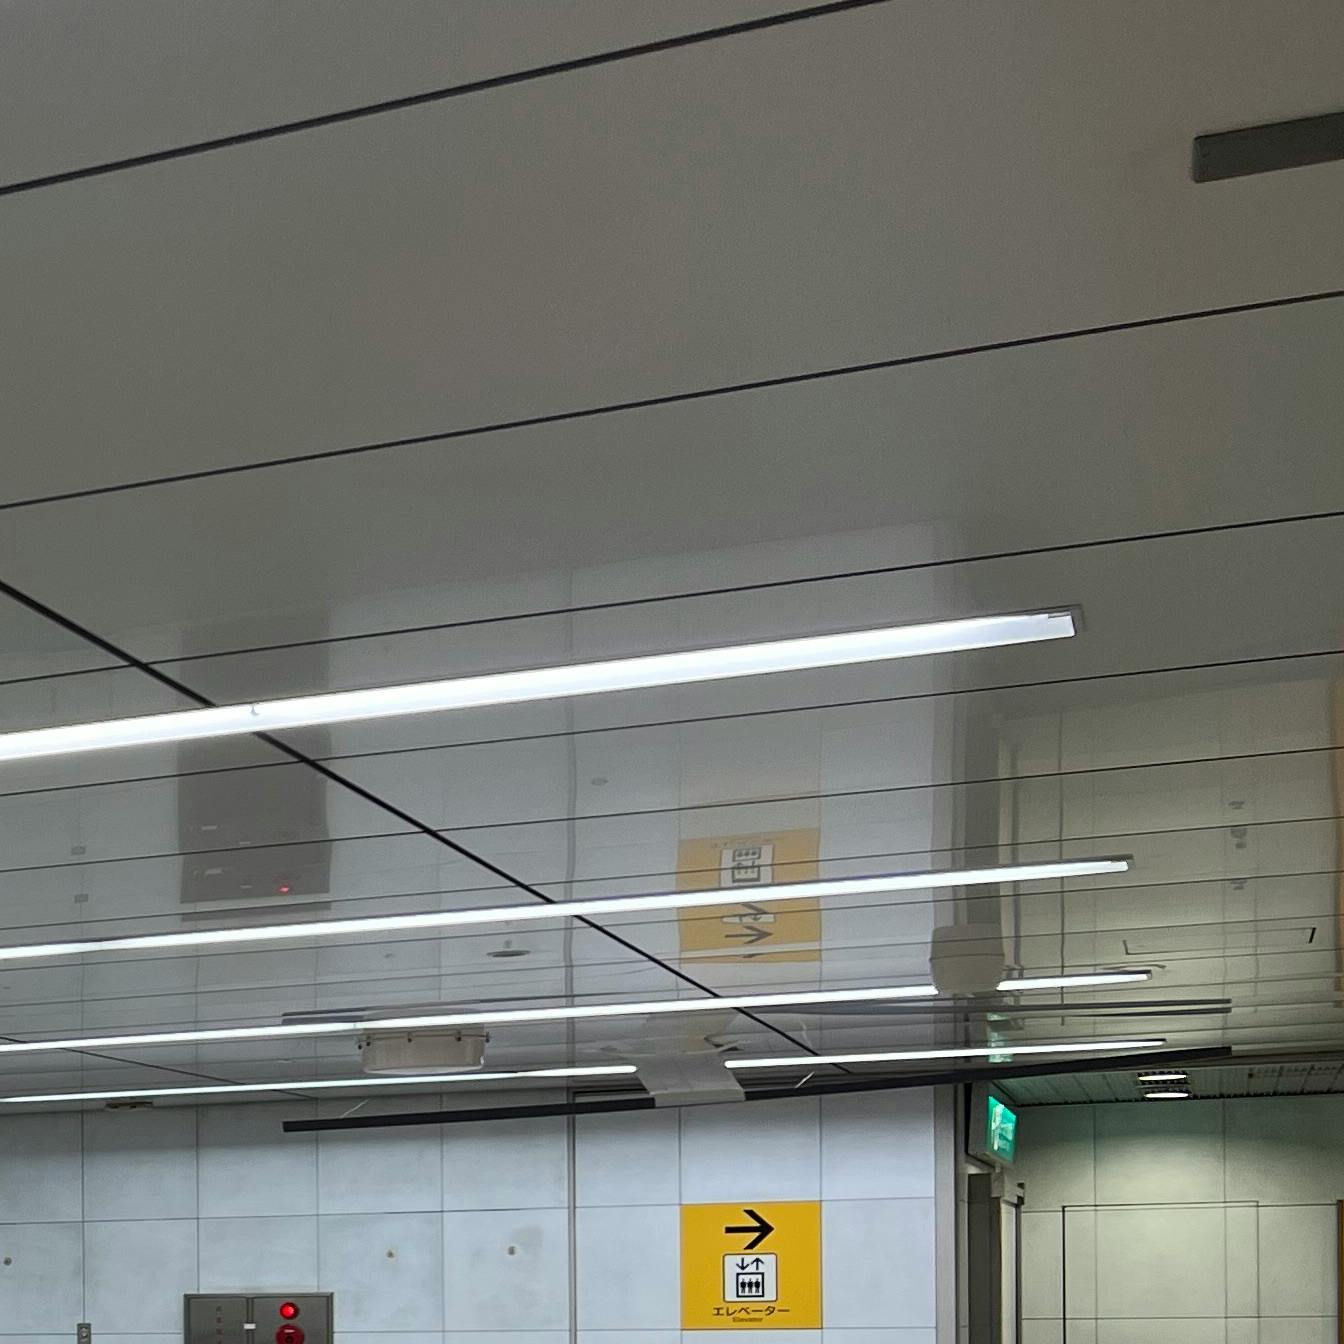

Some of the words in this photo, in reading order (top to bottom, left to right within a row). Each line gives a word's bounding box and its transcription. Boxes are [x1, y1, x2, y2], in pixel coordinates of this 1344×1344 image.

[713, 1305, 790, 1317] エレベーター
